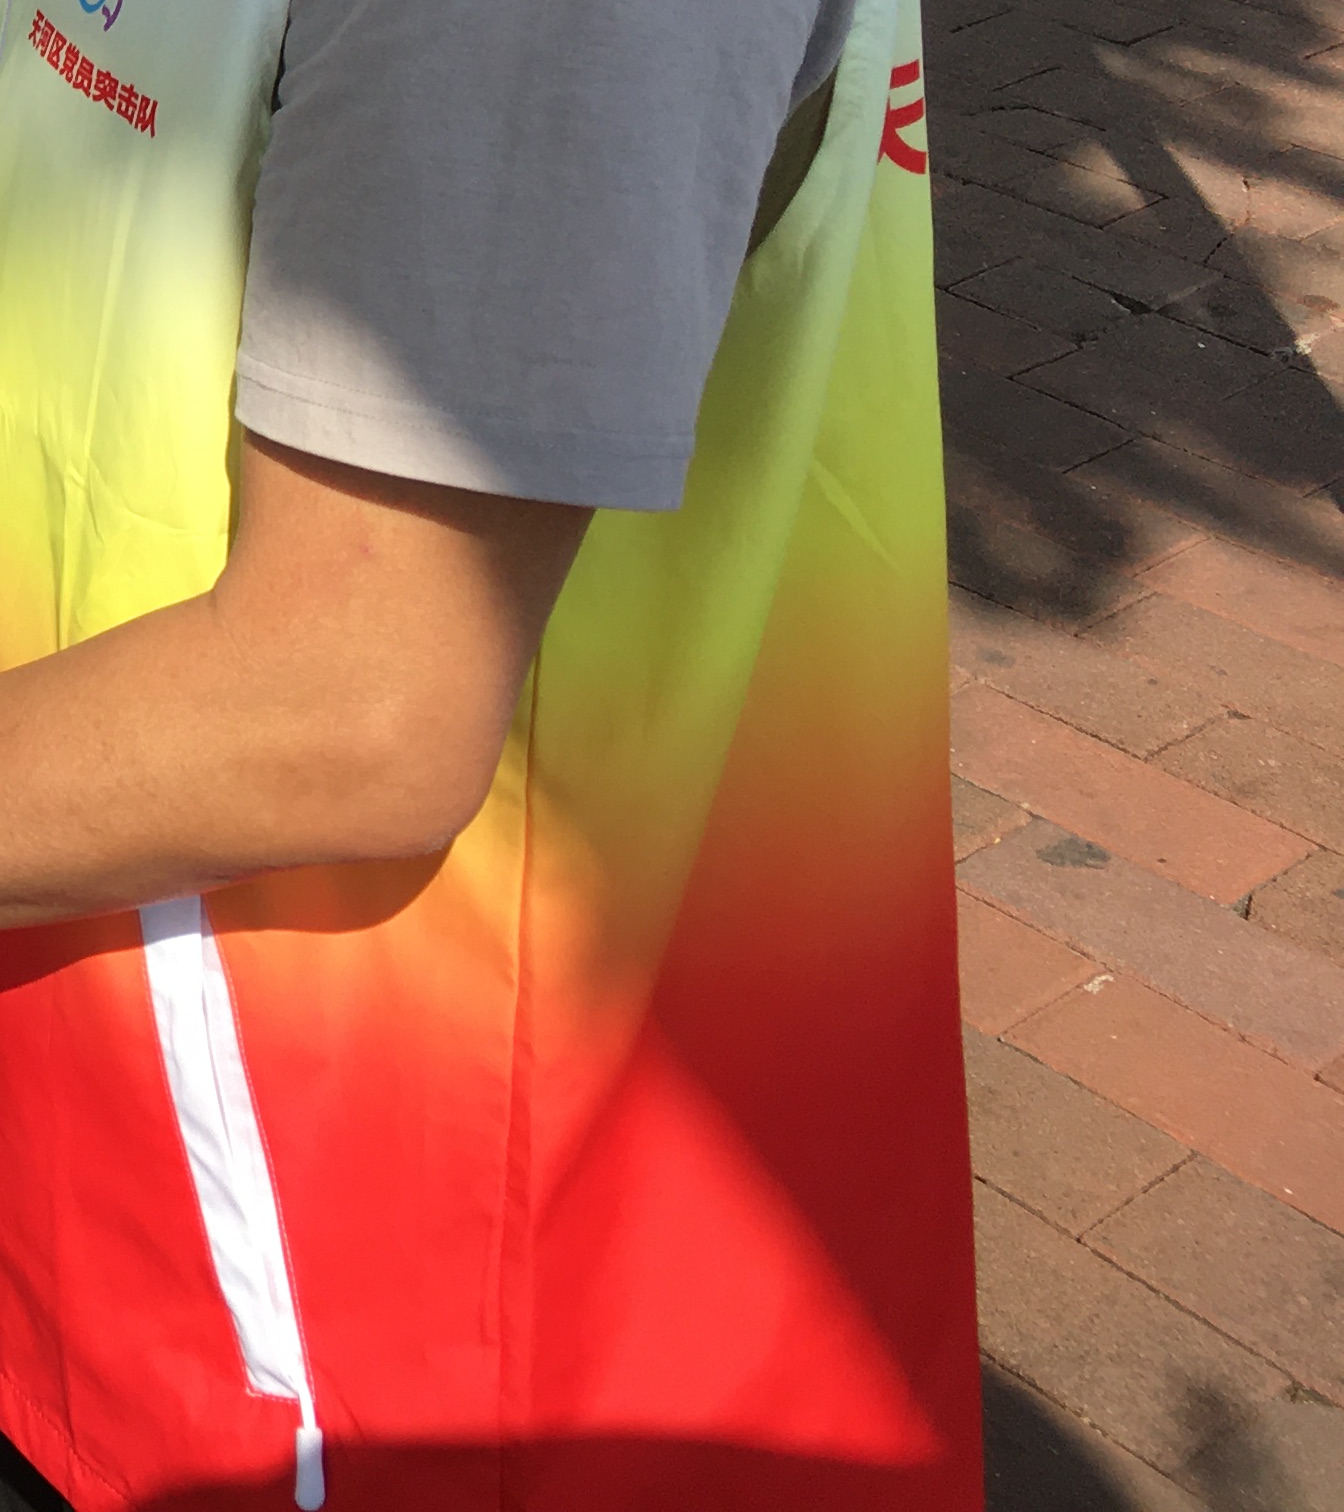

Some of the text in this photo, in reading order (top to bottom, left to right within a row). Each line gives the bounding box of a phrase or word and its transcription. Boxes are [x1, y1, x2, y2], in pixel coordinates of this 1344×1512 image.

[27, 8, 159, 139] 天河区党员突击队
